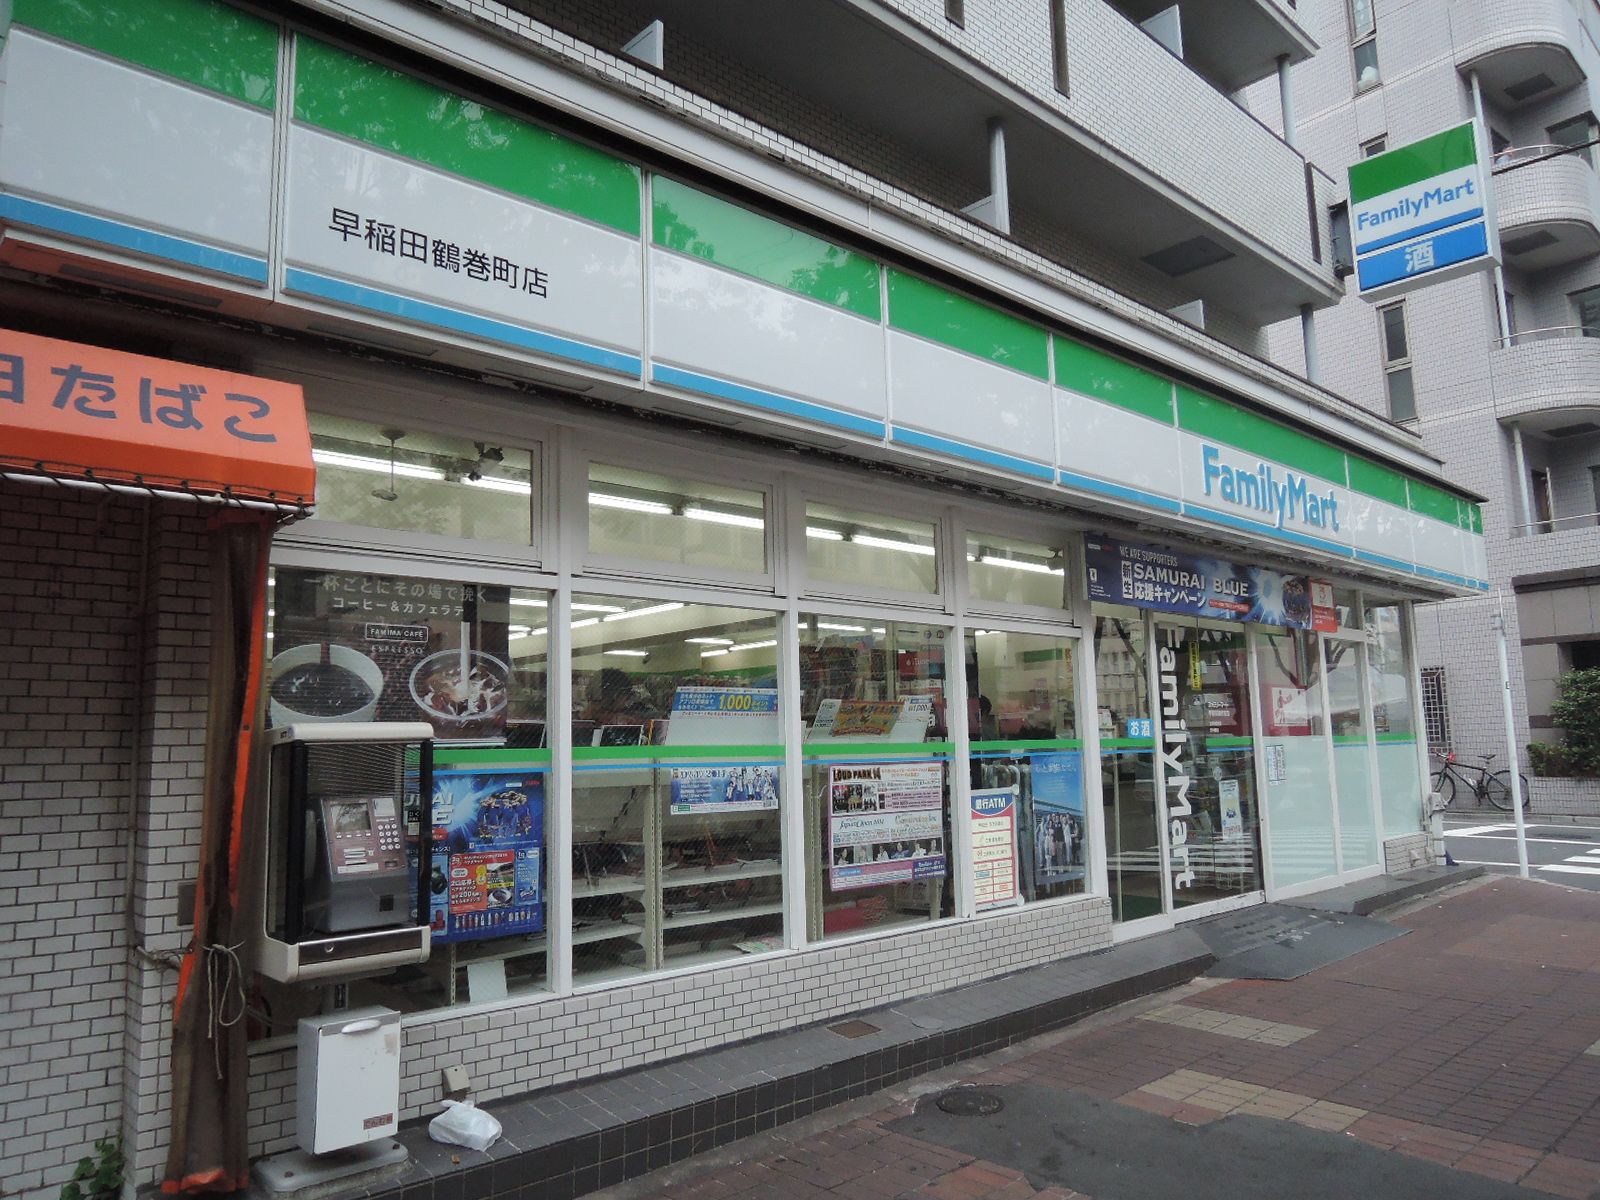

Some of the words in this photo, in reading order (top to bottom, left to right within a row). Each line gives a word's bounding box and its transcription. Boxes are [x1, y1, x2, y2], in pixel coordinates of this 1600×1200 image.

[1357, 179, 1475, 231] FamilyMart
[328, 207, 549, 299] 早稲田鶴巻町店
[1404, 240, 1435, 273] 酒
[1200, 442, 1340, 534] FamilyMart
[1142, 549, 1178, 567] SUPPORTERS
[304, 575, 487, 603] 一杯ごとにその場で挽く
[1133, 563, 1205, 590] SAMURAI
[1213, 580, 1250, 598] BLUE
[370, 628, 402, 638] FAMIMA
[1130, 720, 1151, 738] お酒
[1155, 622, 1195, 890] FamilyMart
[833, 768, 852, 782] LOUD
[853, 768, 872, 780] PARK
